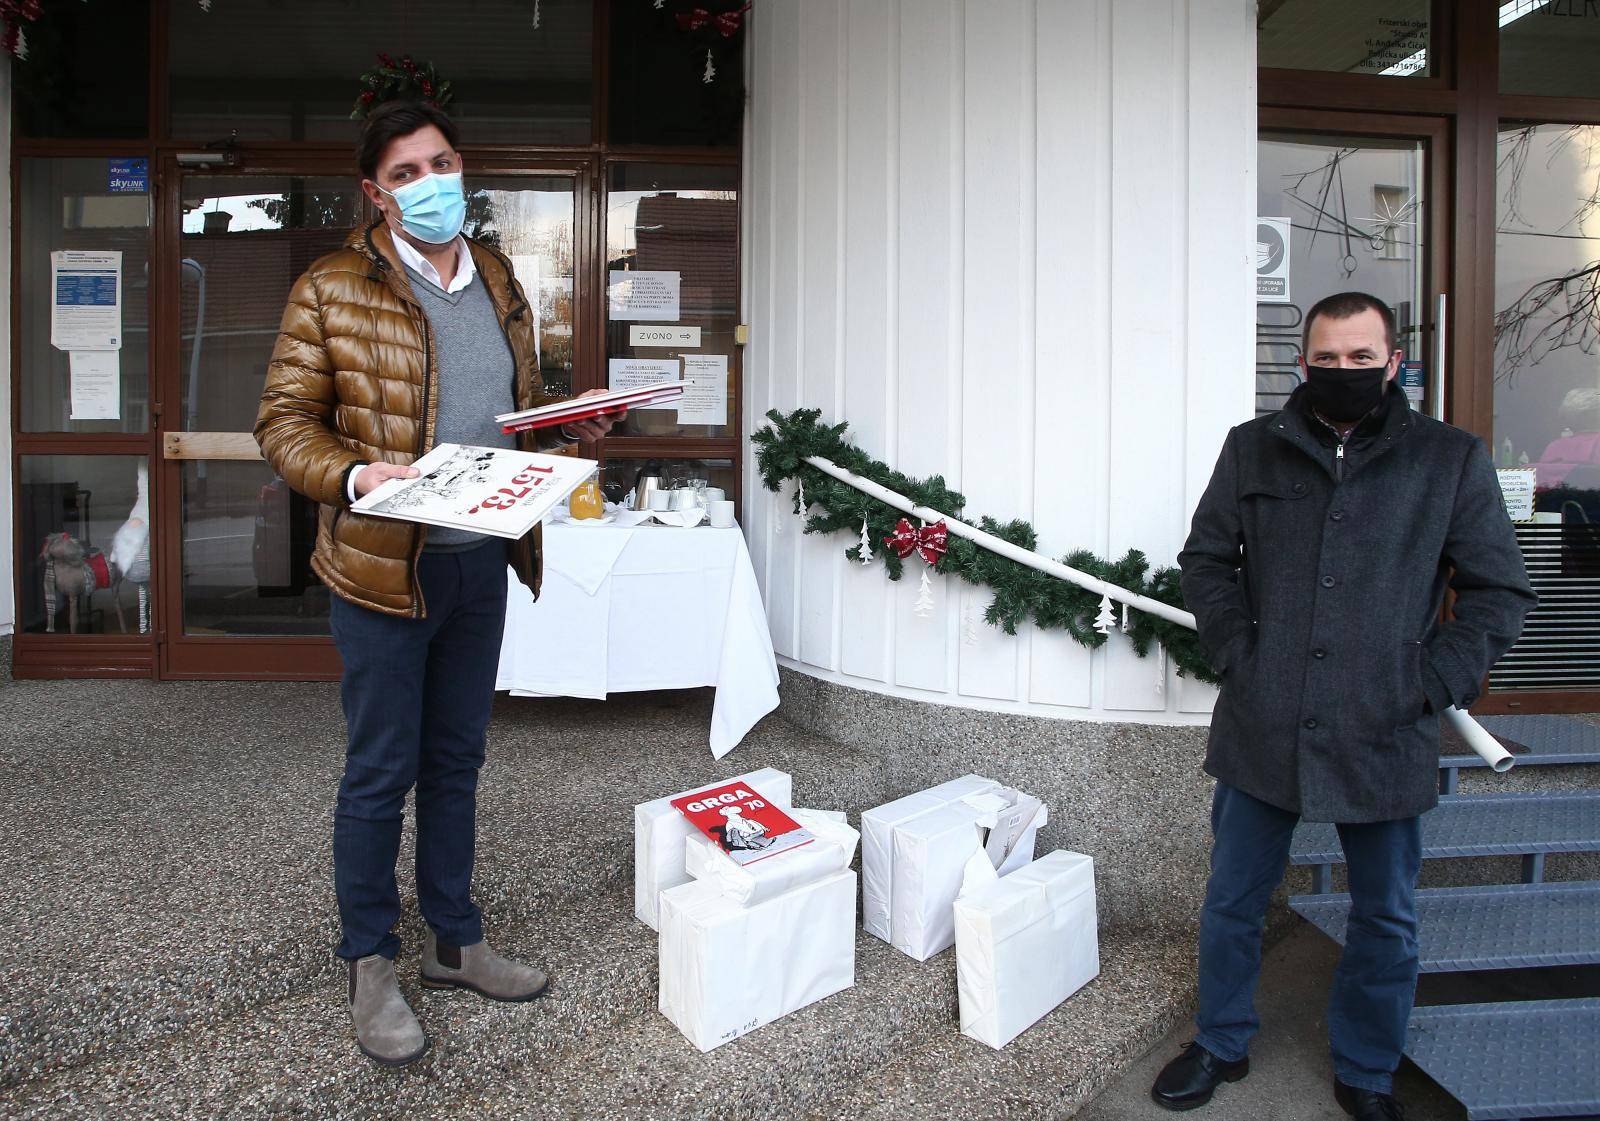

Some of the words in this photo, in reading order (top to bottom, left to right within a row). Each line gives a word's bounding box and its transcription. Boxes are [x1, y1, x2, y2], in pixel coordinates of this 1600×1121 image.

[639, 332, 673, 340] ZVONO
[686, 789, 754, 813] GRGA
[743, 799, 766, 811] 70
